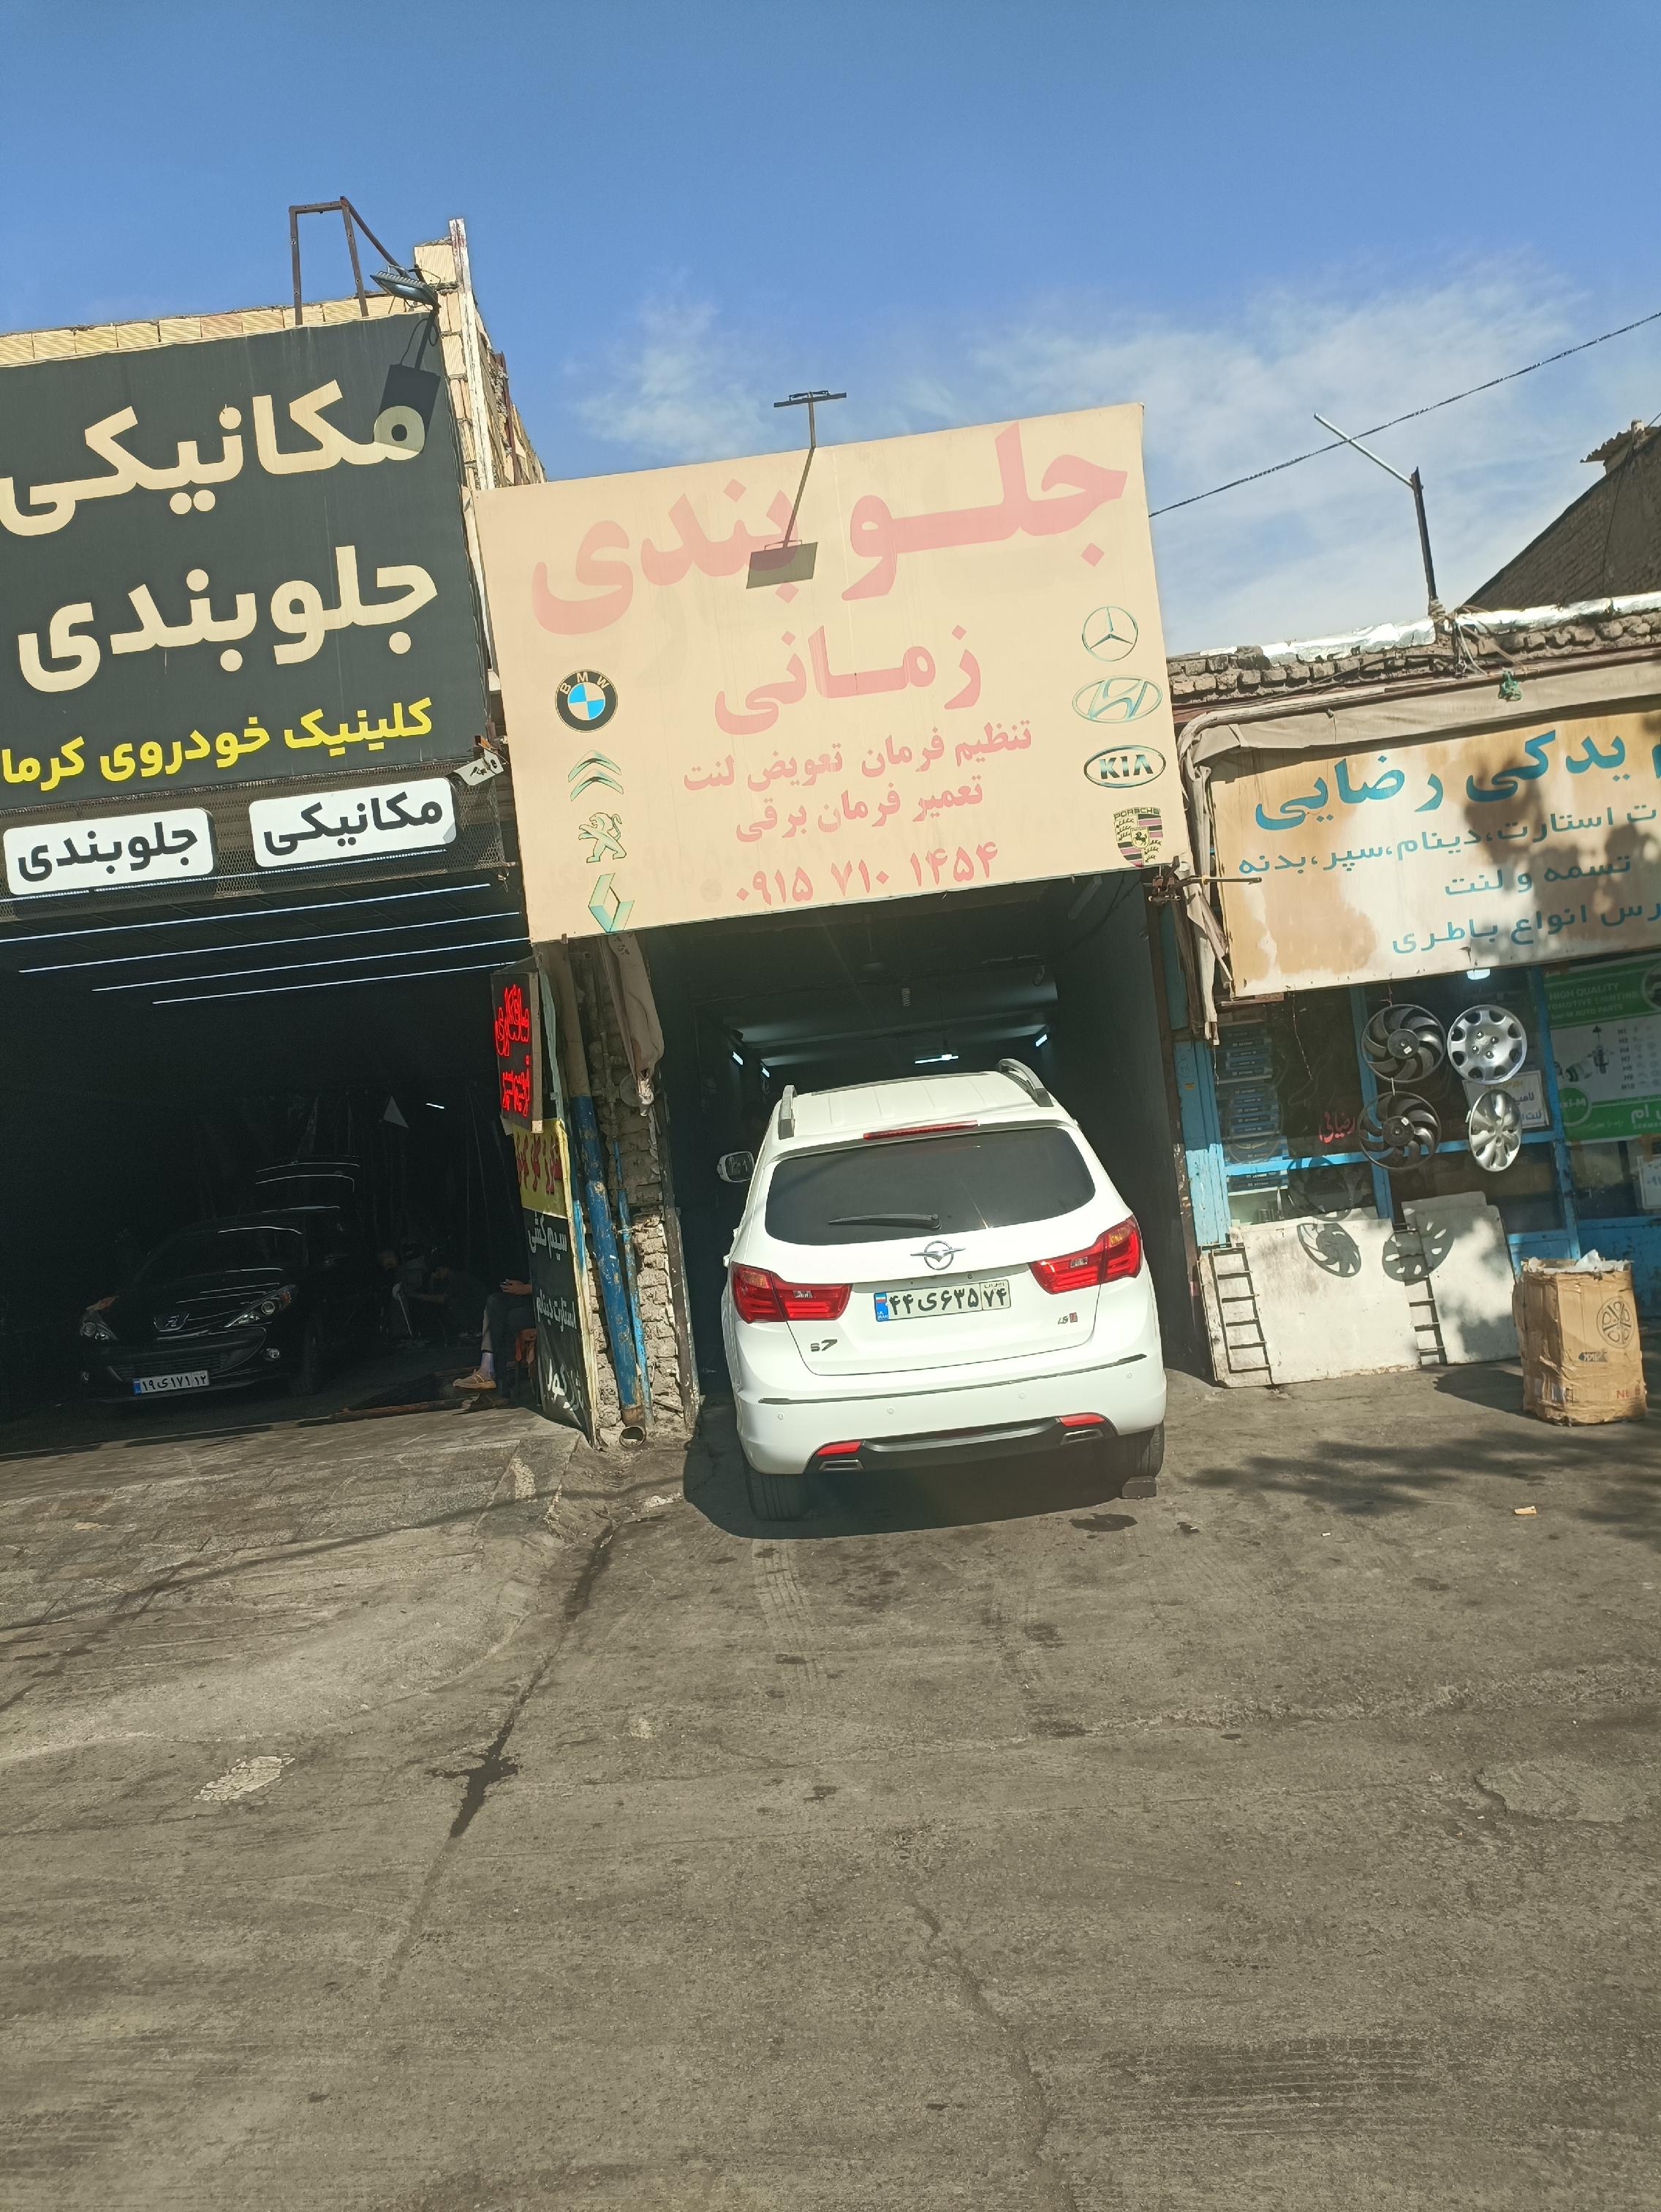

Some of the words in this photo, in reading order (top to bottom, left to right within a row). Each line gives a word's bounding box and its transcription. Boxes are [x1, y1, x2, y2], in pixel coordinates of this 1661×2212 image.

[0, 379, 425, 537] مکانیکی
[17, 545, 438, 692] جلوبندی
[559, 671, 610, 695] BMW
[714, 624, 982, 736] زمانی
[100, 716, 270, 782] خودروی
[284, 697, 433, 757] کلینیک
[955, 720, 1032, 767] تنظیم
[684, 754, 735, 790] لنت
[747, 743, 843, 792] تعویض
[861, 726, 945, 777] فرمان
[1098, 754, 1154, 780] KIA
[1466, 729, 1630, 803] یدکی
[817, 782, 901, 833] فرمان
[912, 774, 983, 822] تعمیر
[1113, 807, 1161, 820] PORSCHE
[1255, 755, 1445, 831] رضایی
[263, 792, 443, 856] مکانیکی
[735, 798, 807, 842] برقی
[17, 822, 198, 882] جلوبندی
[736, 866, 814, 906] ۰۹۱۵
[830, 859, 890, 897] ۷۱۰
[909, 841, 998, 887] ۱۴۵۴
[1543, 855, 1631, 883] تسمه
[1445, 869, 1503, 895] لنت
[1517, 872, 1533, 894] و
[1392, 918, 1498, 954] باطری
[1510, 904, 1587, 945] انواع
[1549, 989, 1574, 1000] HIGH
[1575, 982, 1619, 997] QUALITY
[528, 1211, 547, 1253] کشی
[547, 1227, 567, 1261] سیم
[810, 1339, 838, 1352] S7
